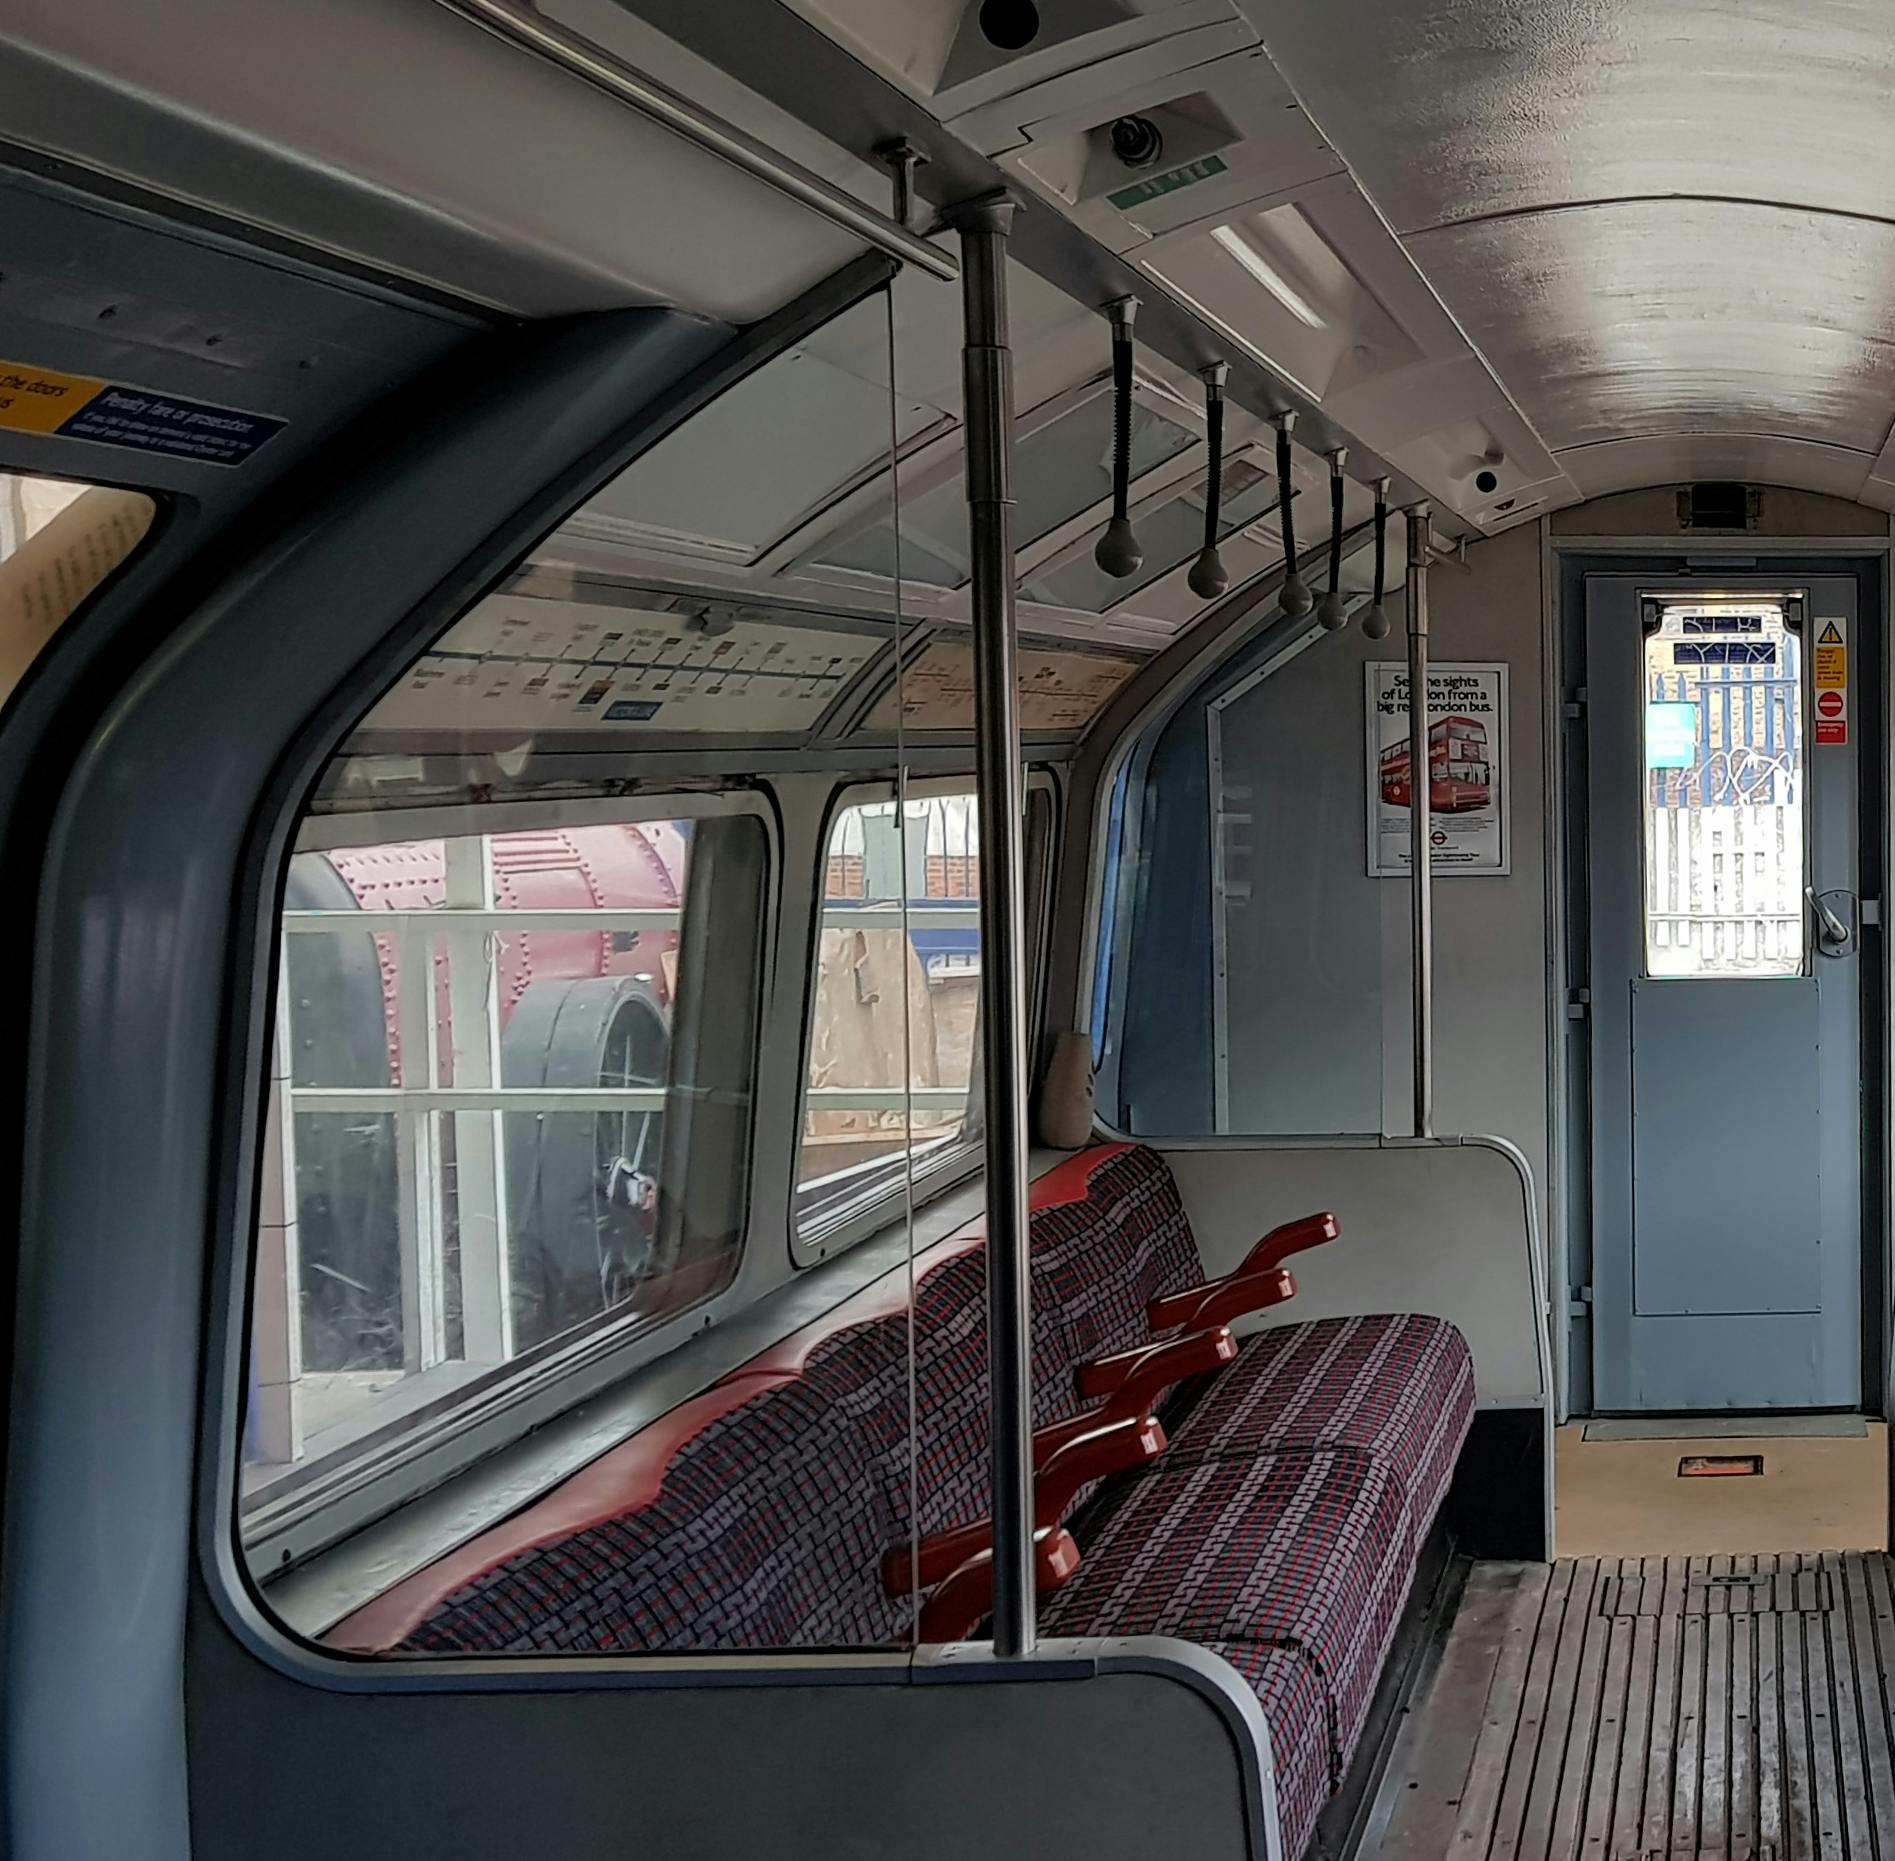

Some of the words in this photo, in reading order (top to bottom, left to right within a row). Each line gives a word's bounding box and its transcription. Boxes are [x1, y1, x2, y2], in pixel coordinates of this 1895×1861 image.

[1443, 676, 1479, 690] sights
[1382, 689, 1396, 700] of
[1398, 689, 1445, 700] Loon
[1448, 689, 1478, 700] from
[1480, 691, 1487, 700] a
[1377, 701, 1395, 715] big
[1427, 701, 1467, 712] ondon
[1470, 701, 1493, 712] bus.
